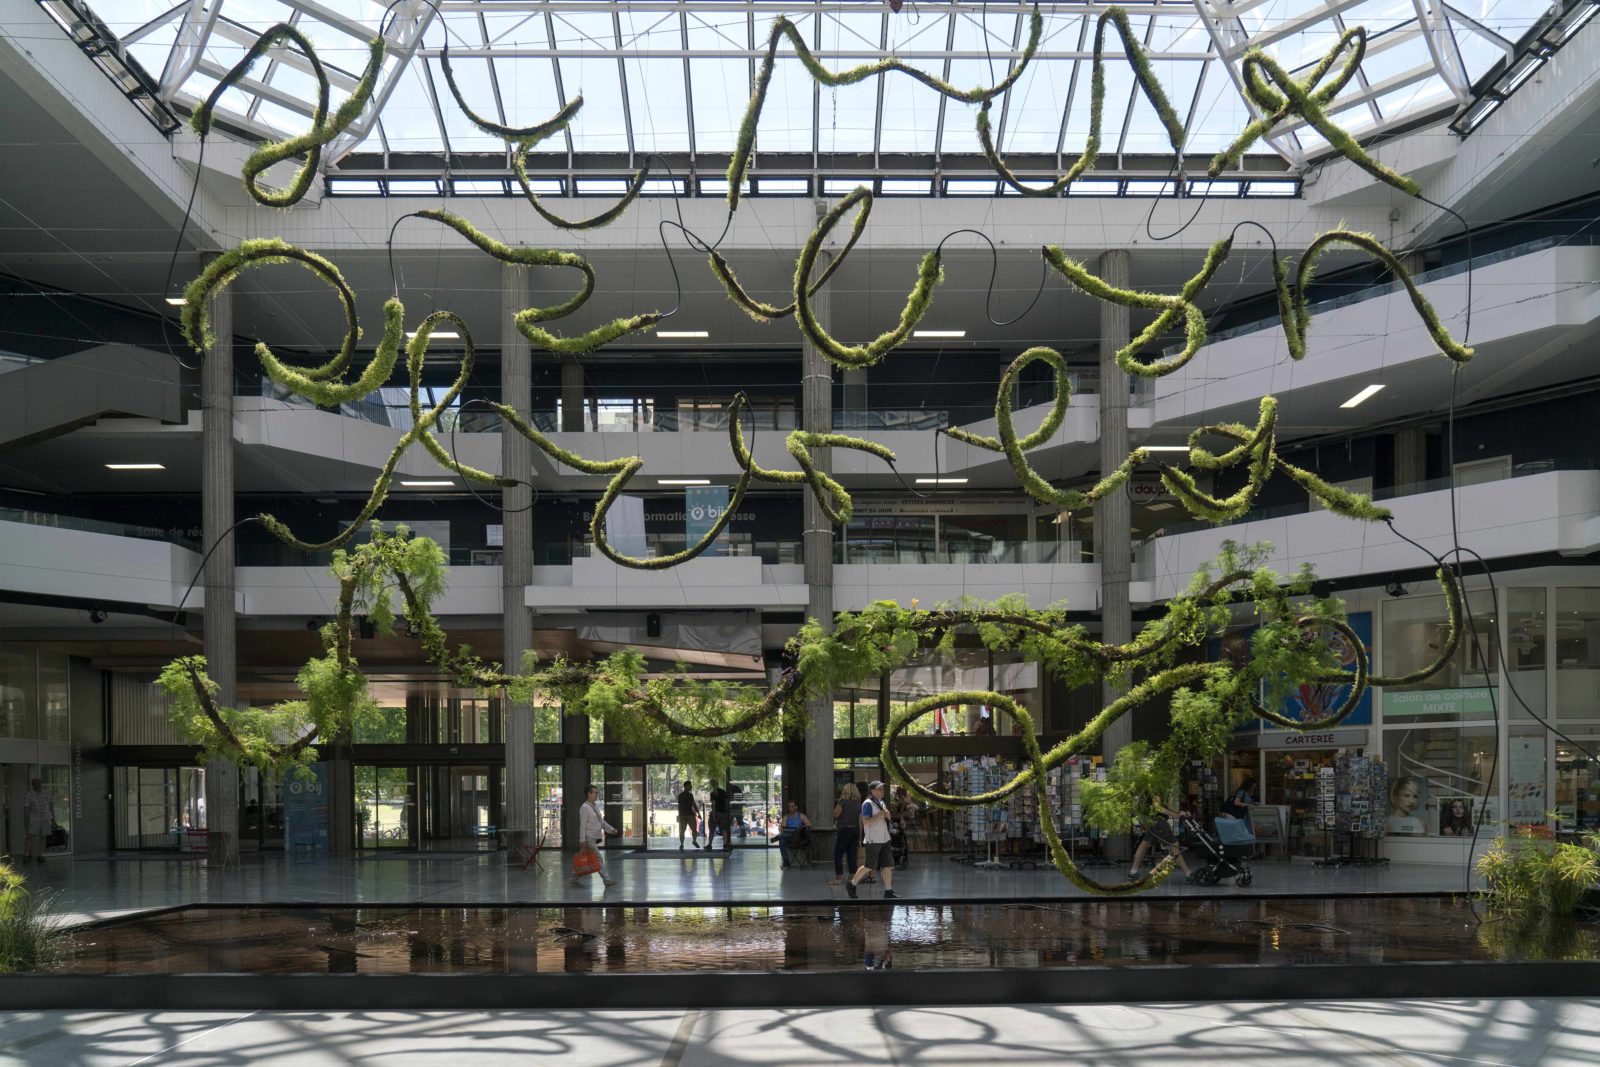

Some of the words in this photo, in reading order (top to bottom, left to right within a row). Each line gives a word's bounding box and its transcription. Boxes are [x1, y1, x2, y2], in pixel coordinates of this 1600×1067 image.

[1392, 693, 1423, 703] Salon
[1425, 691, 1441, 701] de
[1443, 689, 1488, 701] coiffure
[1423, 702, 1456, 713] MIXTE
[1285, 734, 1335, 745] CARTERIE
